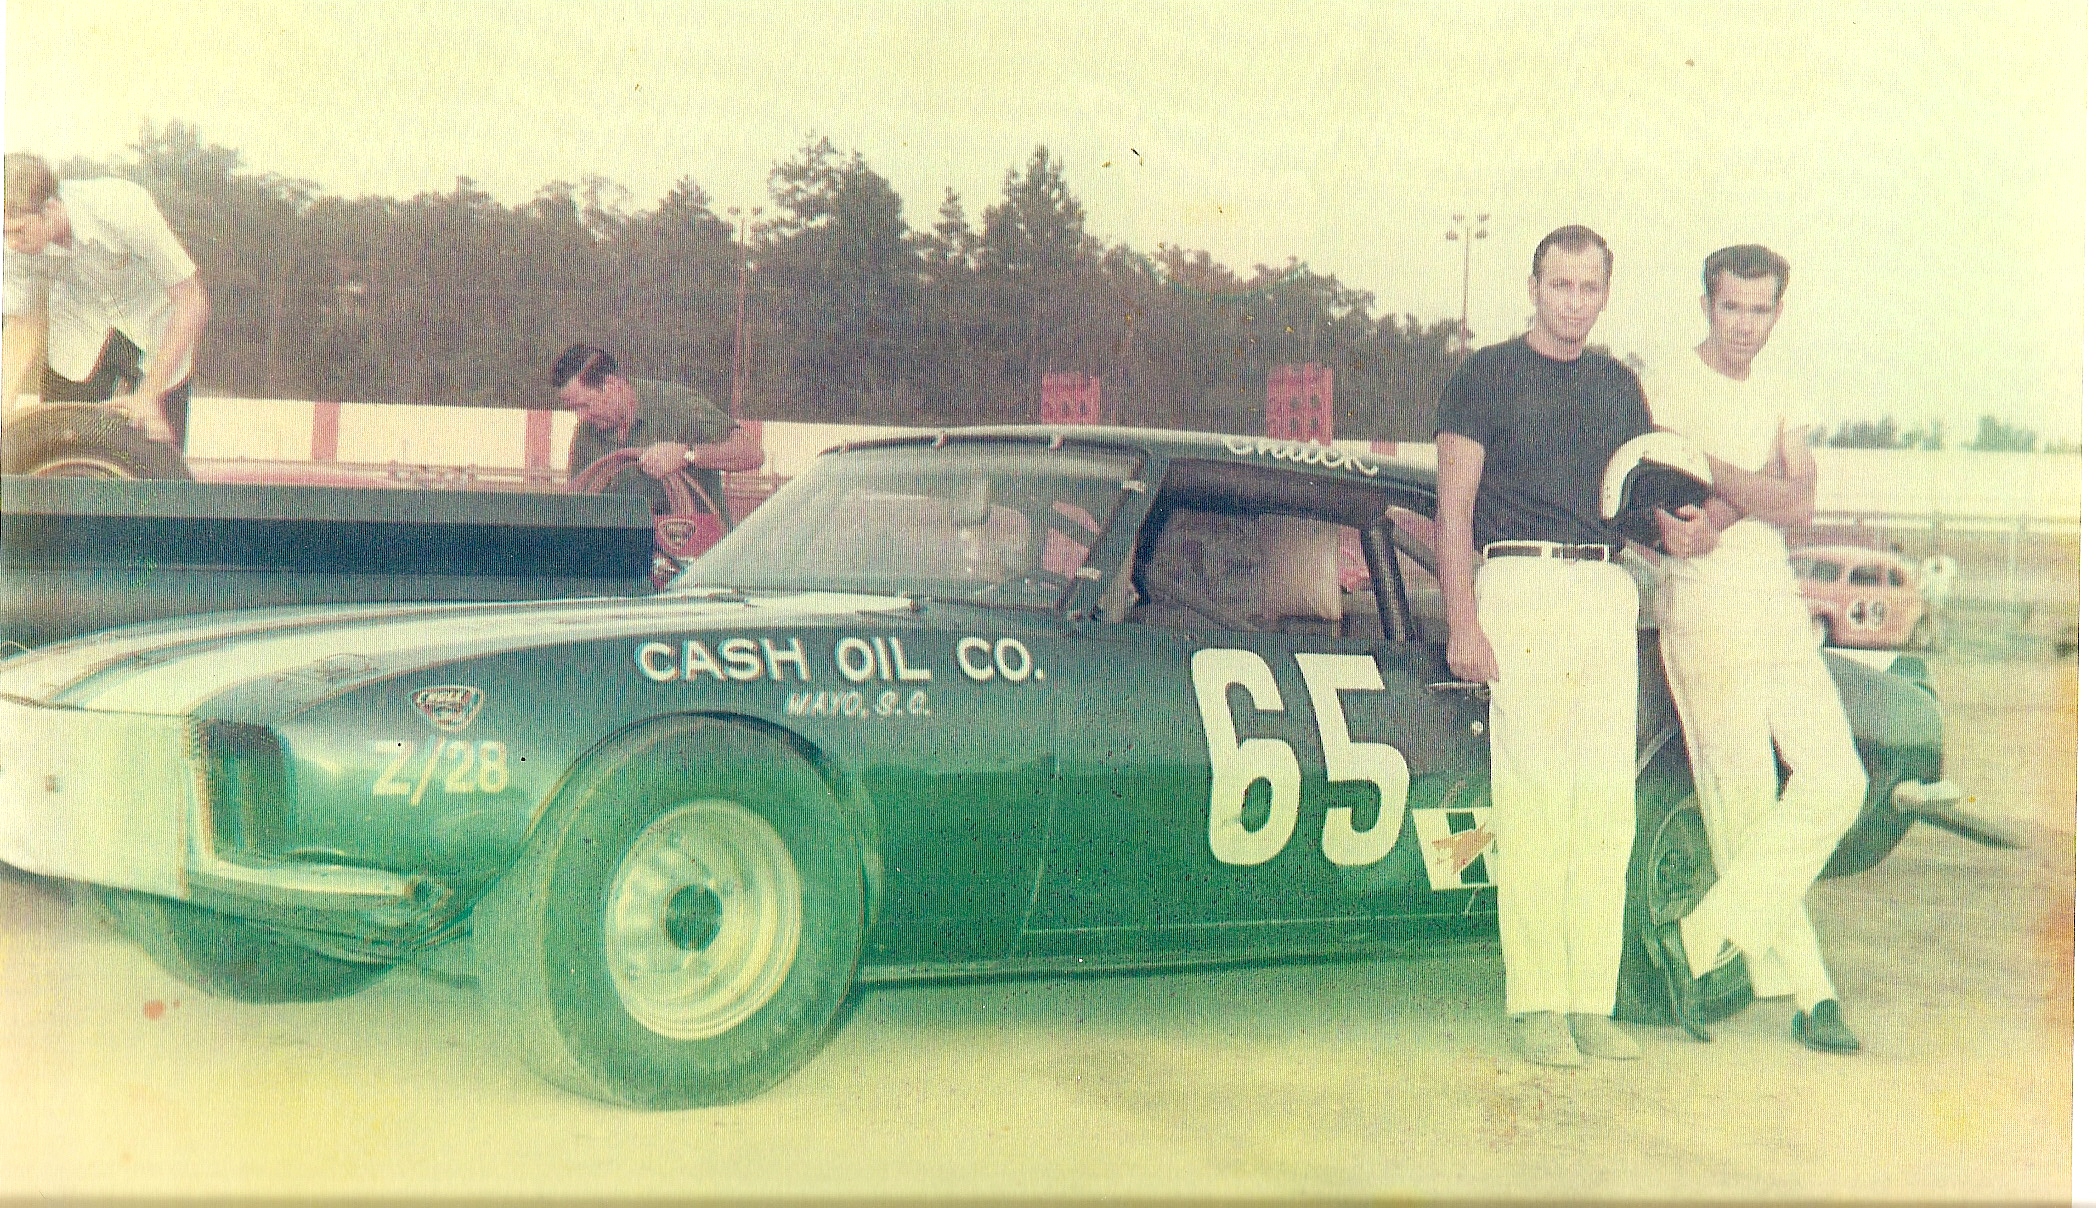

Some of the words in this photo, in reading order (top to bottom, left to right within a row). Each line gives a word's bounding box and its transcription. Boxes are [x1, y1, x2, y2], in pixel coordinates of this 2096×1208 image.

[634, 638, 810, 683] CASH
[834, 636, 932, 684] OIL
[955, 636, 1045, 682] CO.
[372, 736, 509, 806] Z/28
[1190, 647, 1410, 867] 65
